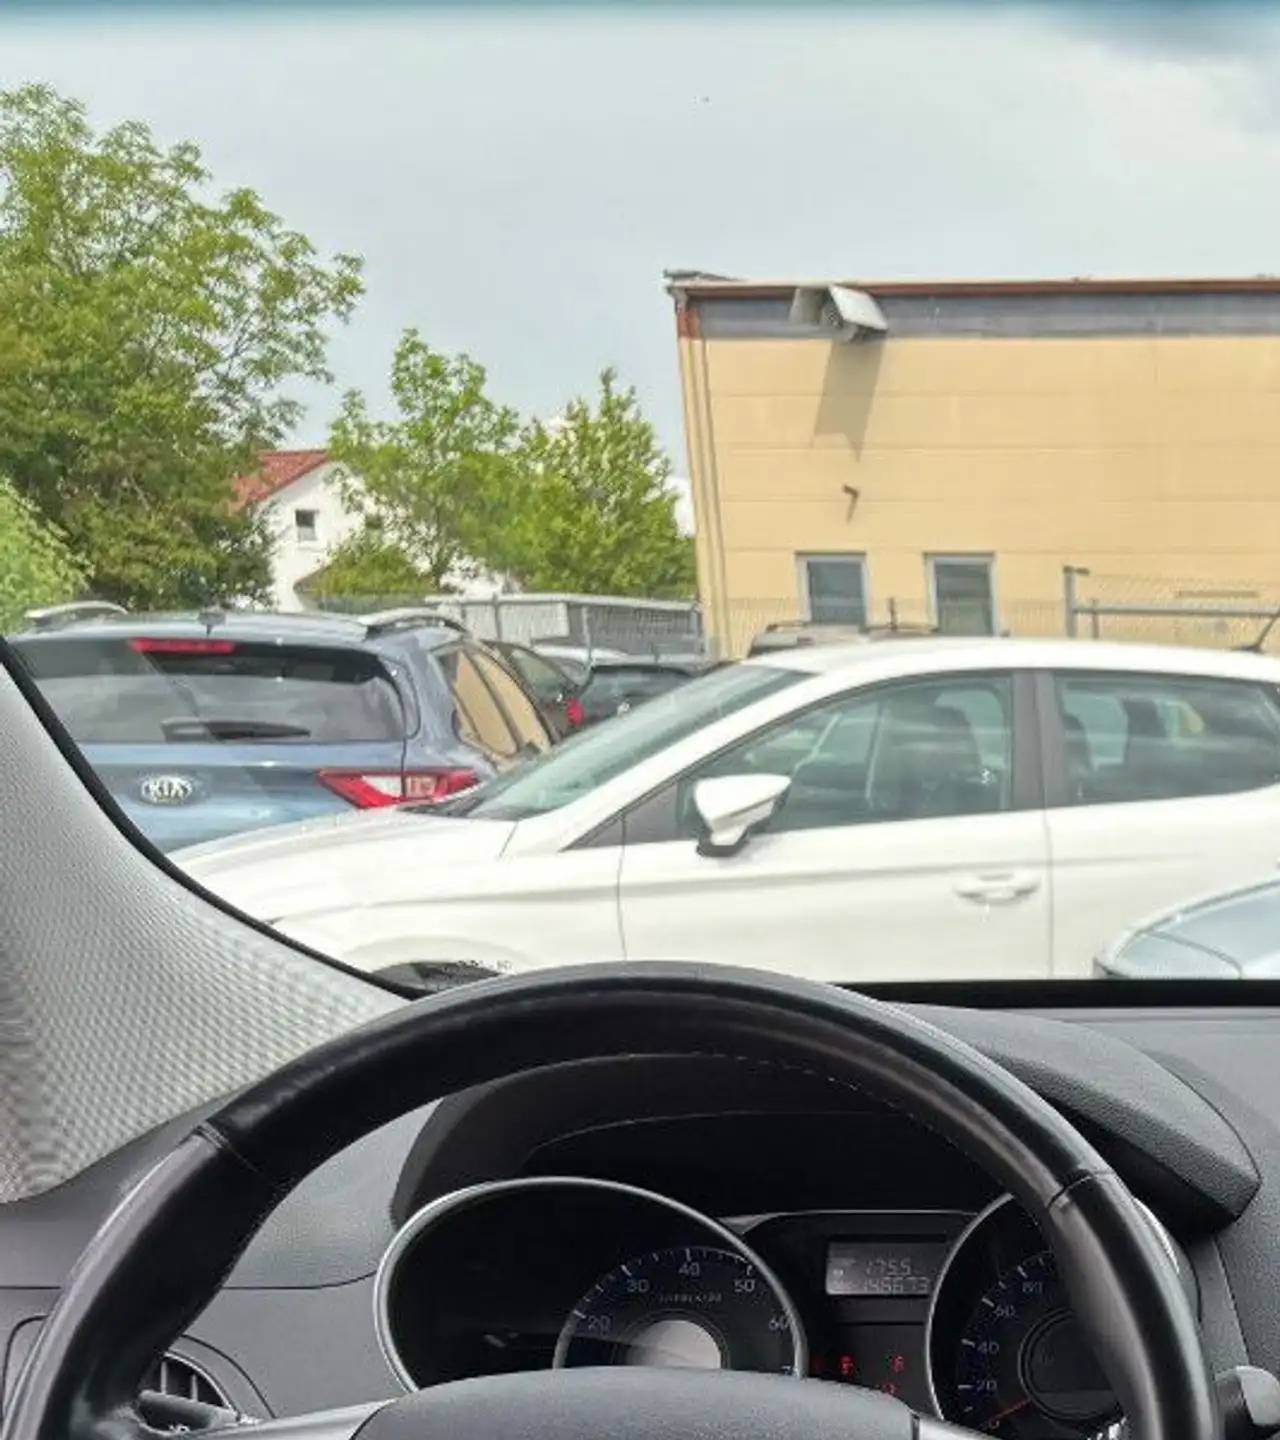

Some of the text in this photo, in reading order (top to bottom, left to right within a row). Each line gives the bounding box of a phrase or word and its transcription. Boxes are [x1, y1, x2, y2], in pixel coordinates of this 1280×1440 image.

[678, 1262, 700, 1276] 40
[626, 1279, 650, 1293] 30
[734, 1280, 756, 1293] 50
[587, 1316, 611, 1331] 20
[768, 1318, 791, 1332] 60
[975, 1380, 998, 1392] 20
